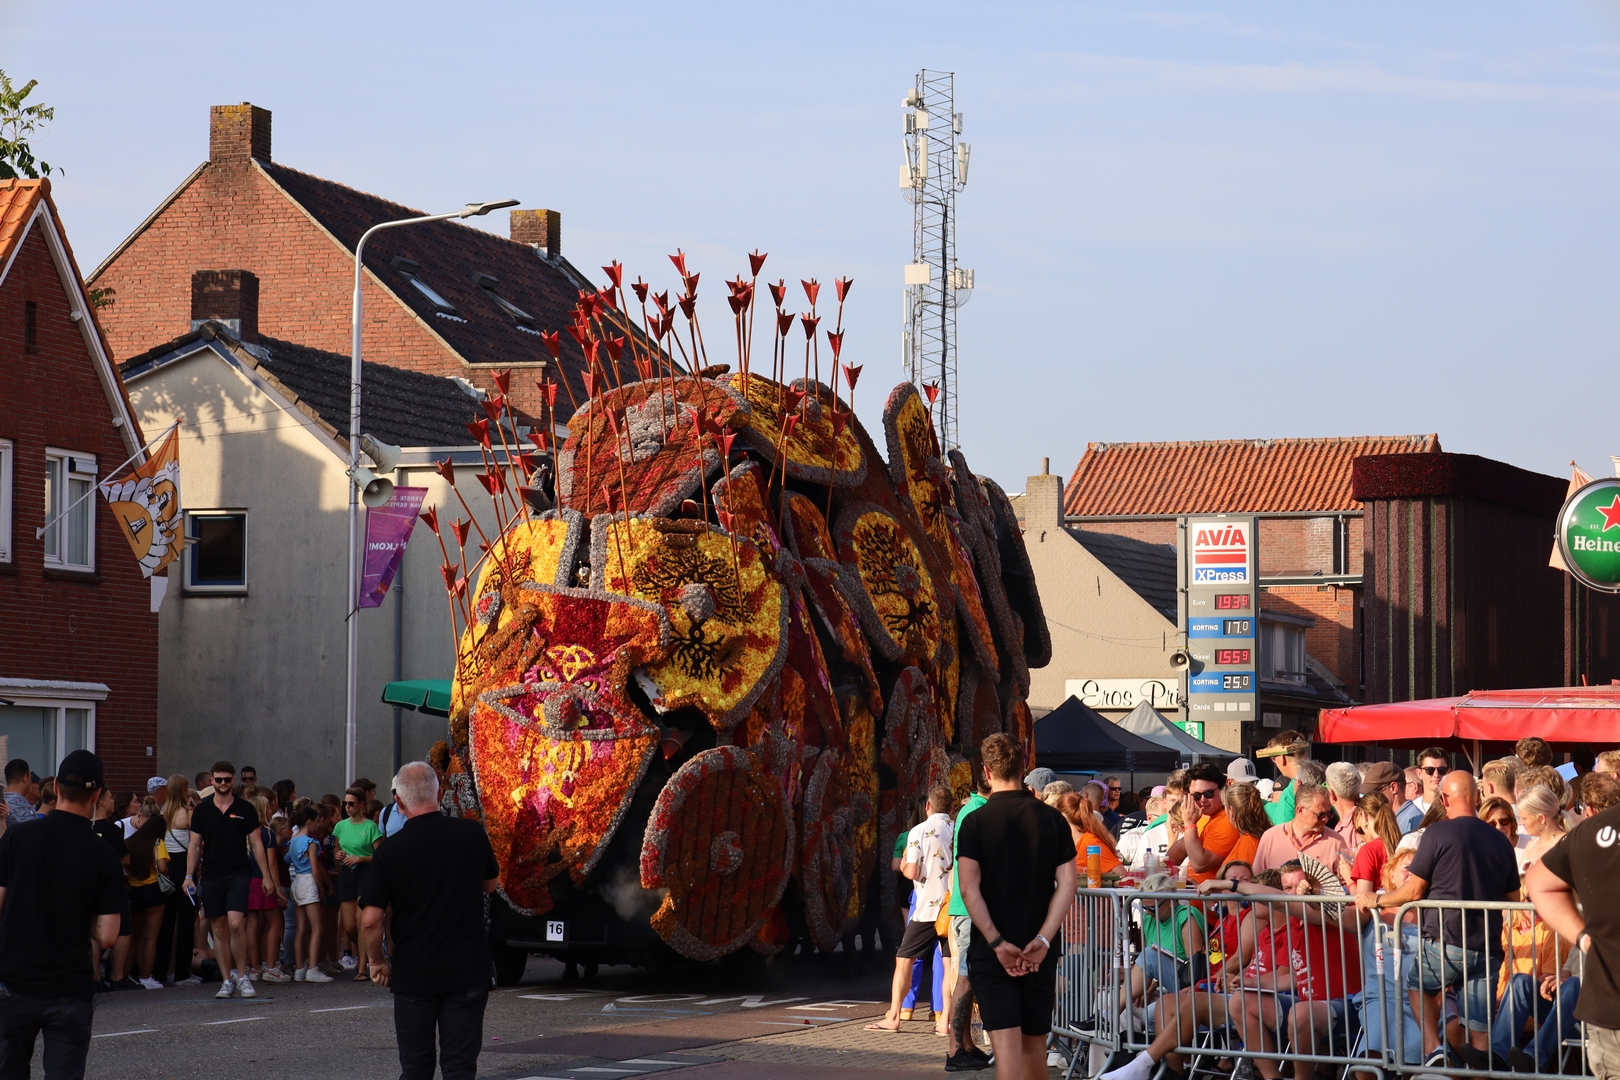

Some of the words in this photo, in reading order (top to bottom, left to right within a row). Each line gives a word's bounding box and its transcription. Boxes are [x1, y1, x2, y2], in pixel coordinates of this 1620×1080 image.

[1195, 525, 1246, 546] AVIA
[1196, 569, 1245, 581] XPress
[1223, 675, 1249, 689] 25.0
[1080, 680, 1132, 707] Eros
[549, 923, 563, 935] 16
